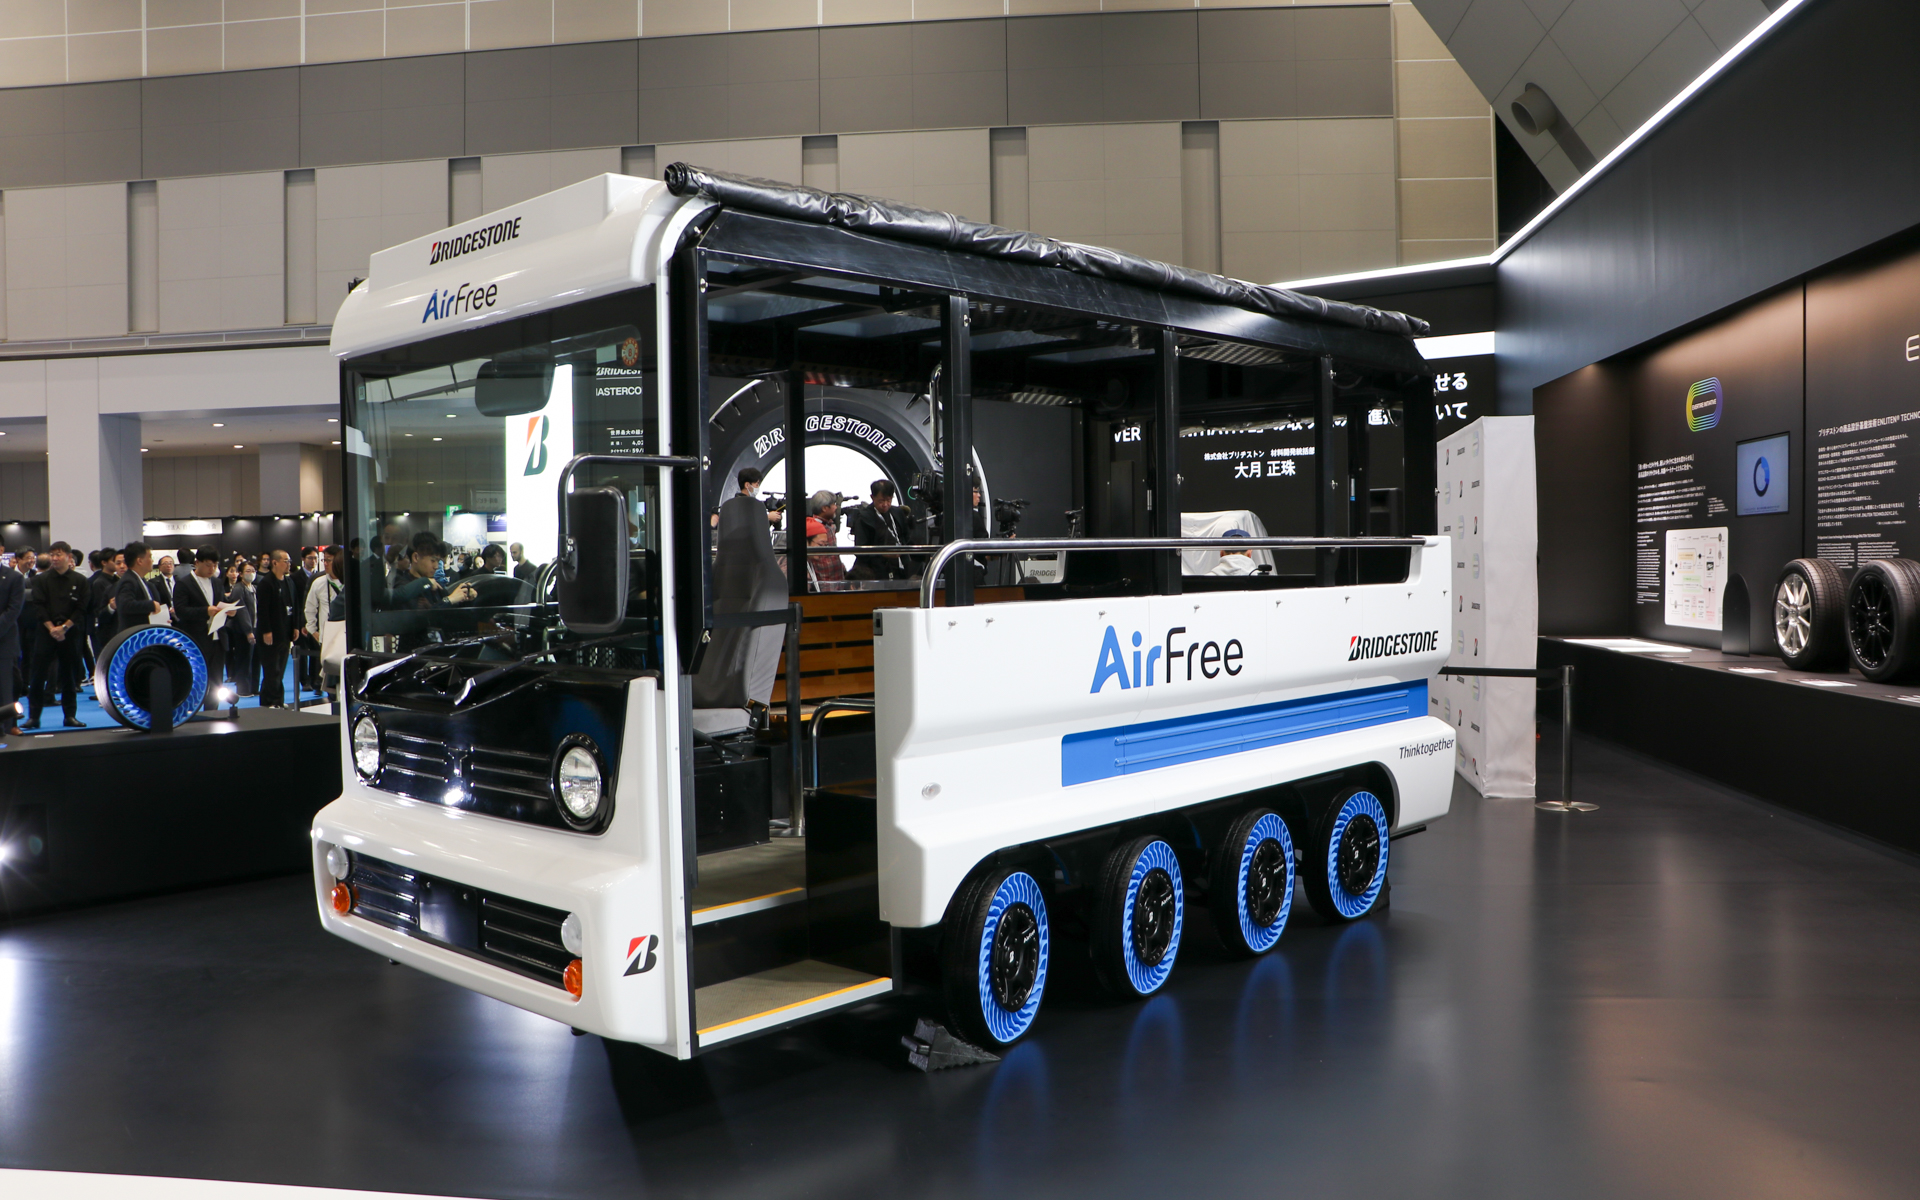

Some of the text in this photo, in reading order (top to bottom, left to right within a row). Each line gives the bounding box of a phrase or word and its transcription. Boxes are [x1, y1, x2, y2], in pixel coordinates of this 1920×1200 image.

[429, 216, 522, 265] BRIDGESTONE
[422, 282, 498, 323] AirFree
[1234, 459, 1296, 479] 大月 正珠
[1089, 625, 1244, 694] AirFree
[1348, 630, 1439, 661] BRIDGESTONE
[1399, 737, 1455, 760] Thinktogether
